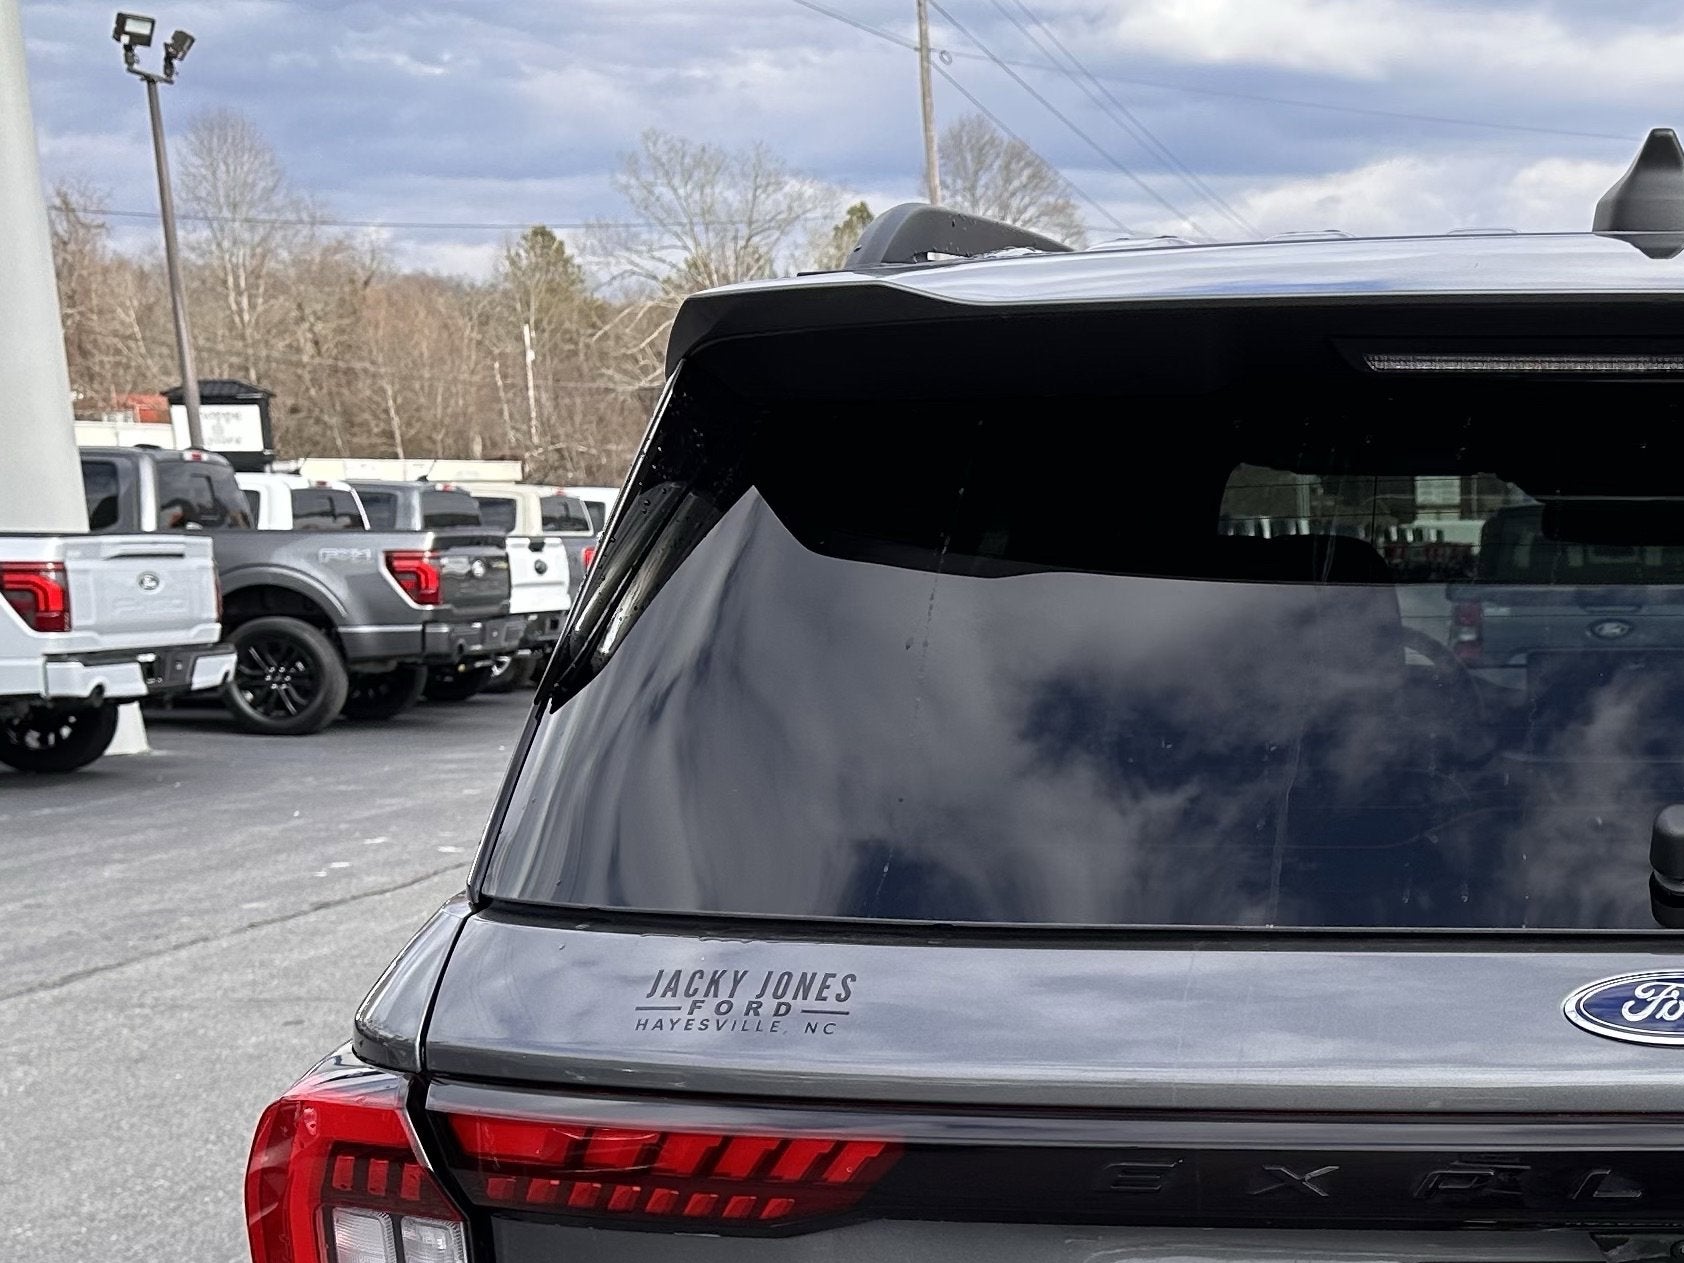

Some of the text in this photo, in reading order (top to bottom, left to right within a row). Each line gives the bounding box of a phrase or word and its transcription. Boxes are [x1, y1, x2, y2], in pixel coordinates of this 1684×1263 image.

[646, 969, 857, 1003] JACKY JONES
[687, 1000, 792, 1017] FORD
[804, 1022, 837, 1035] NC
